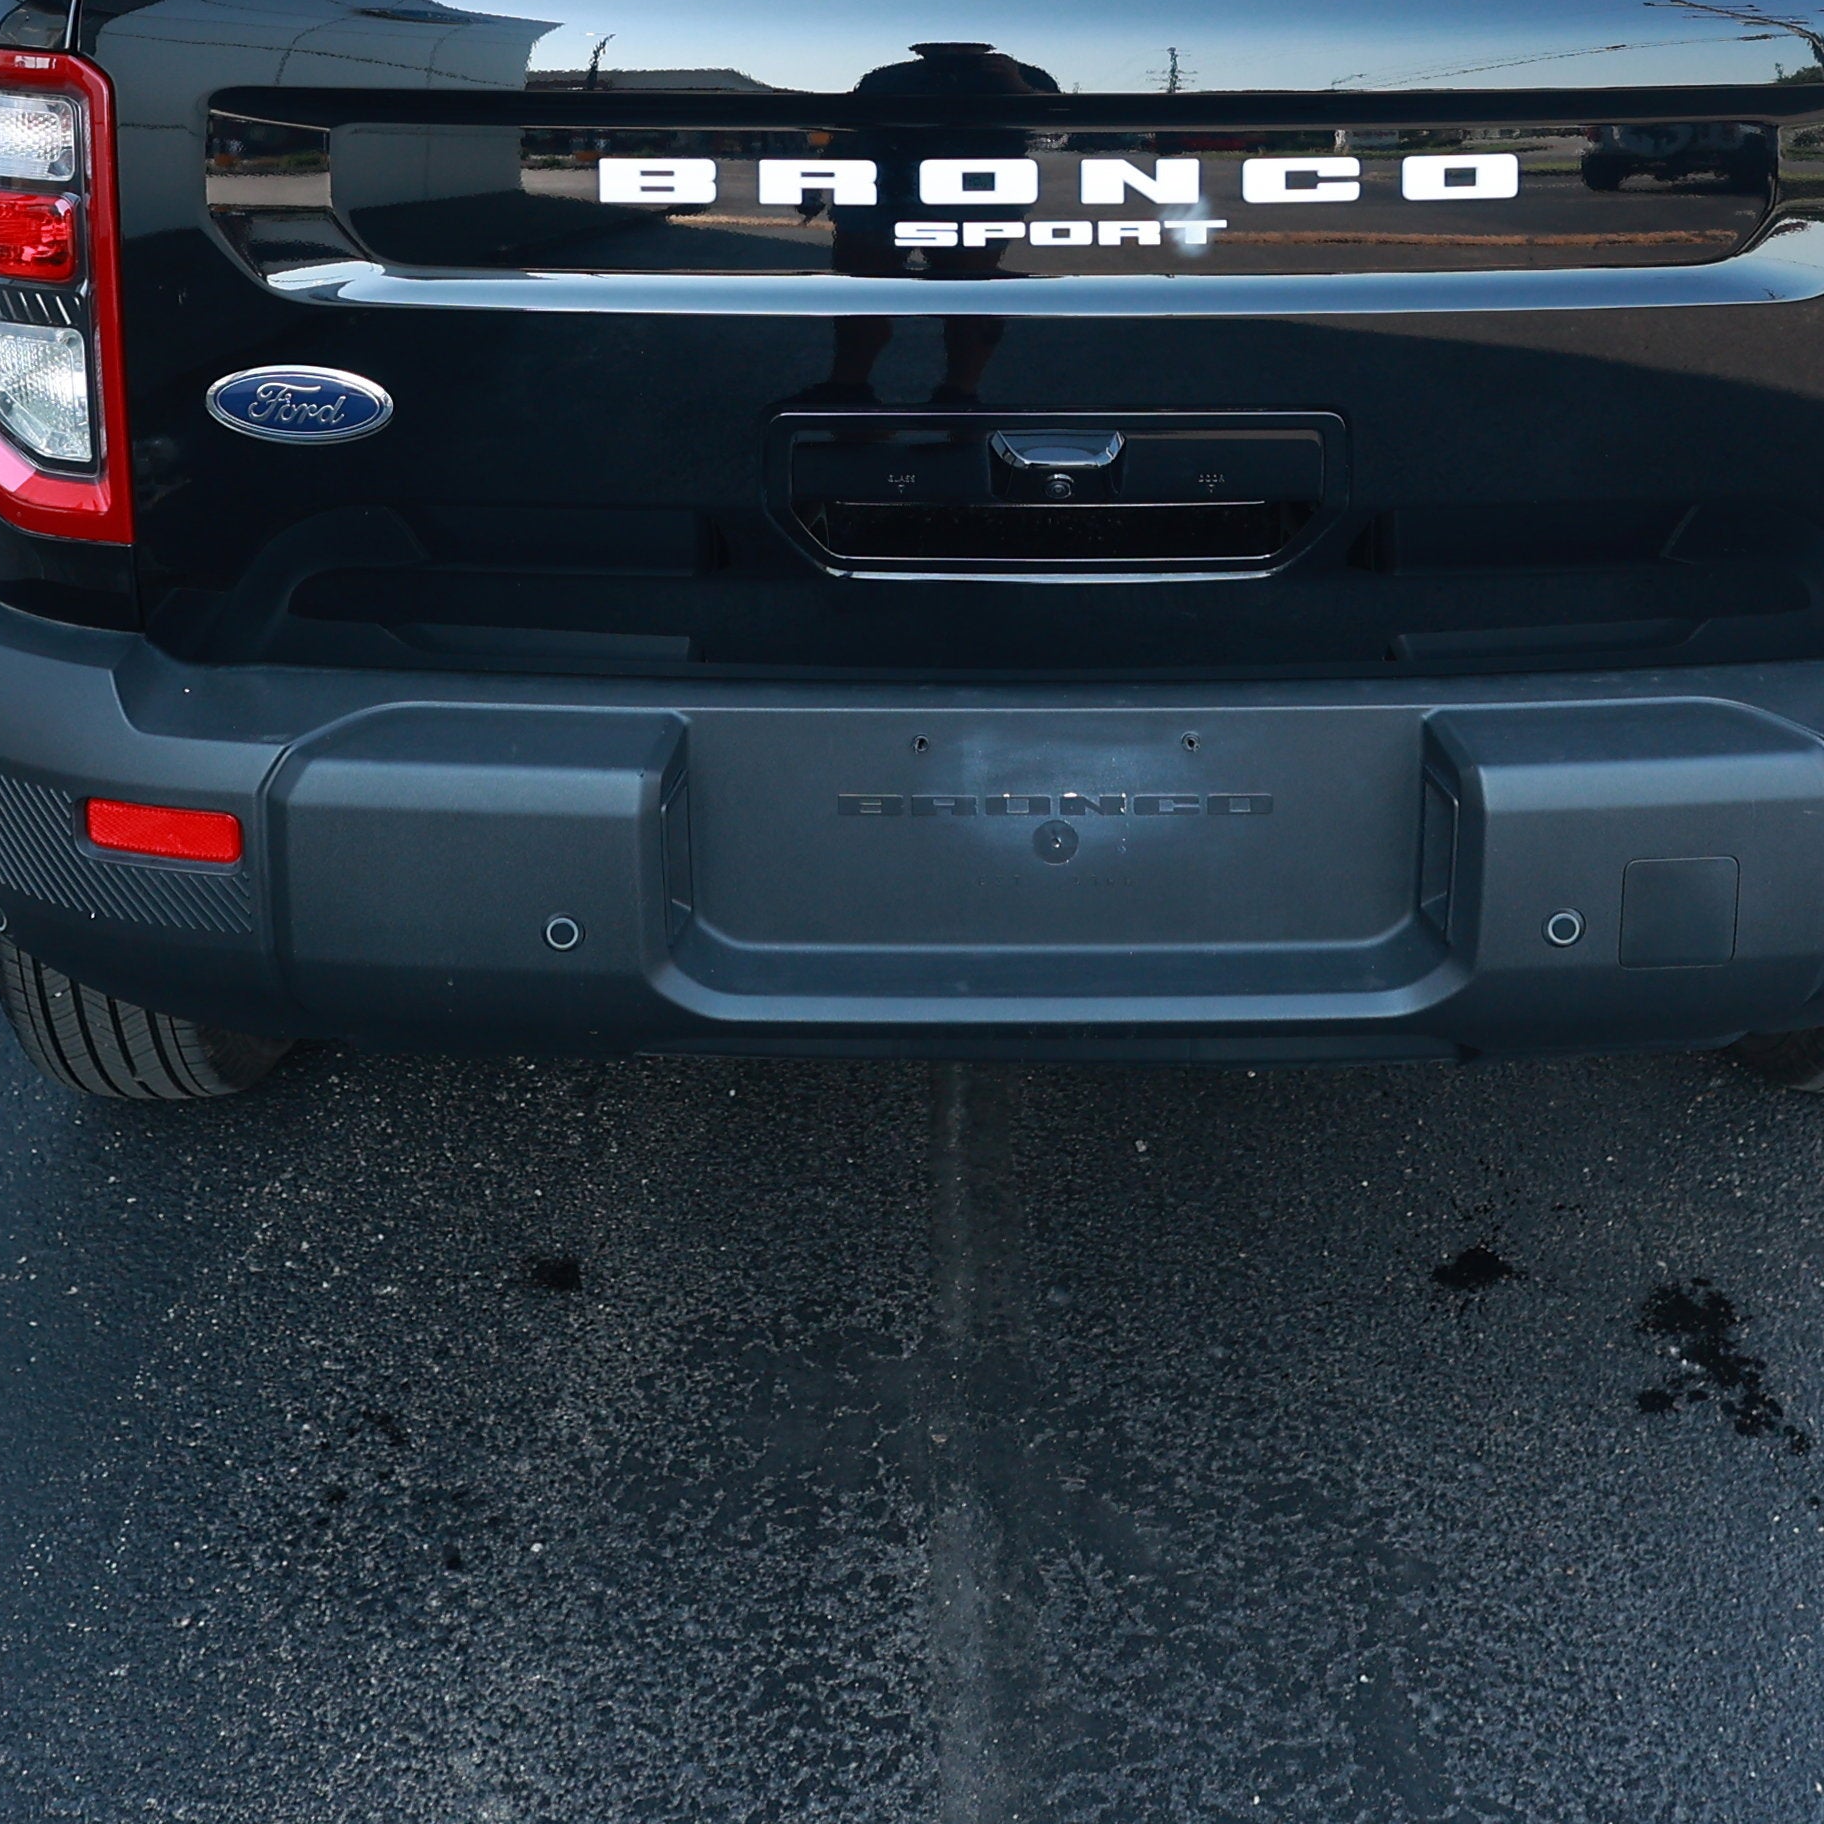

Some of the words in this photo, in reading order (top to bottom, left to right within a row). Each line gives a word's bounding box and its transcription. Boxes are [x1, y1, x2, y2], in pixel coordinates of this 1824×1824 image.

[598, 154, 1519, 205] BRONCO
[893, 219, 1228, 248] SPORT
[249, 382, 346, 425] Ford
[837, 793, 1274, 816] BRONCO
